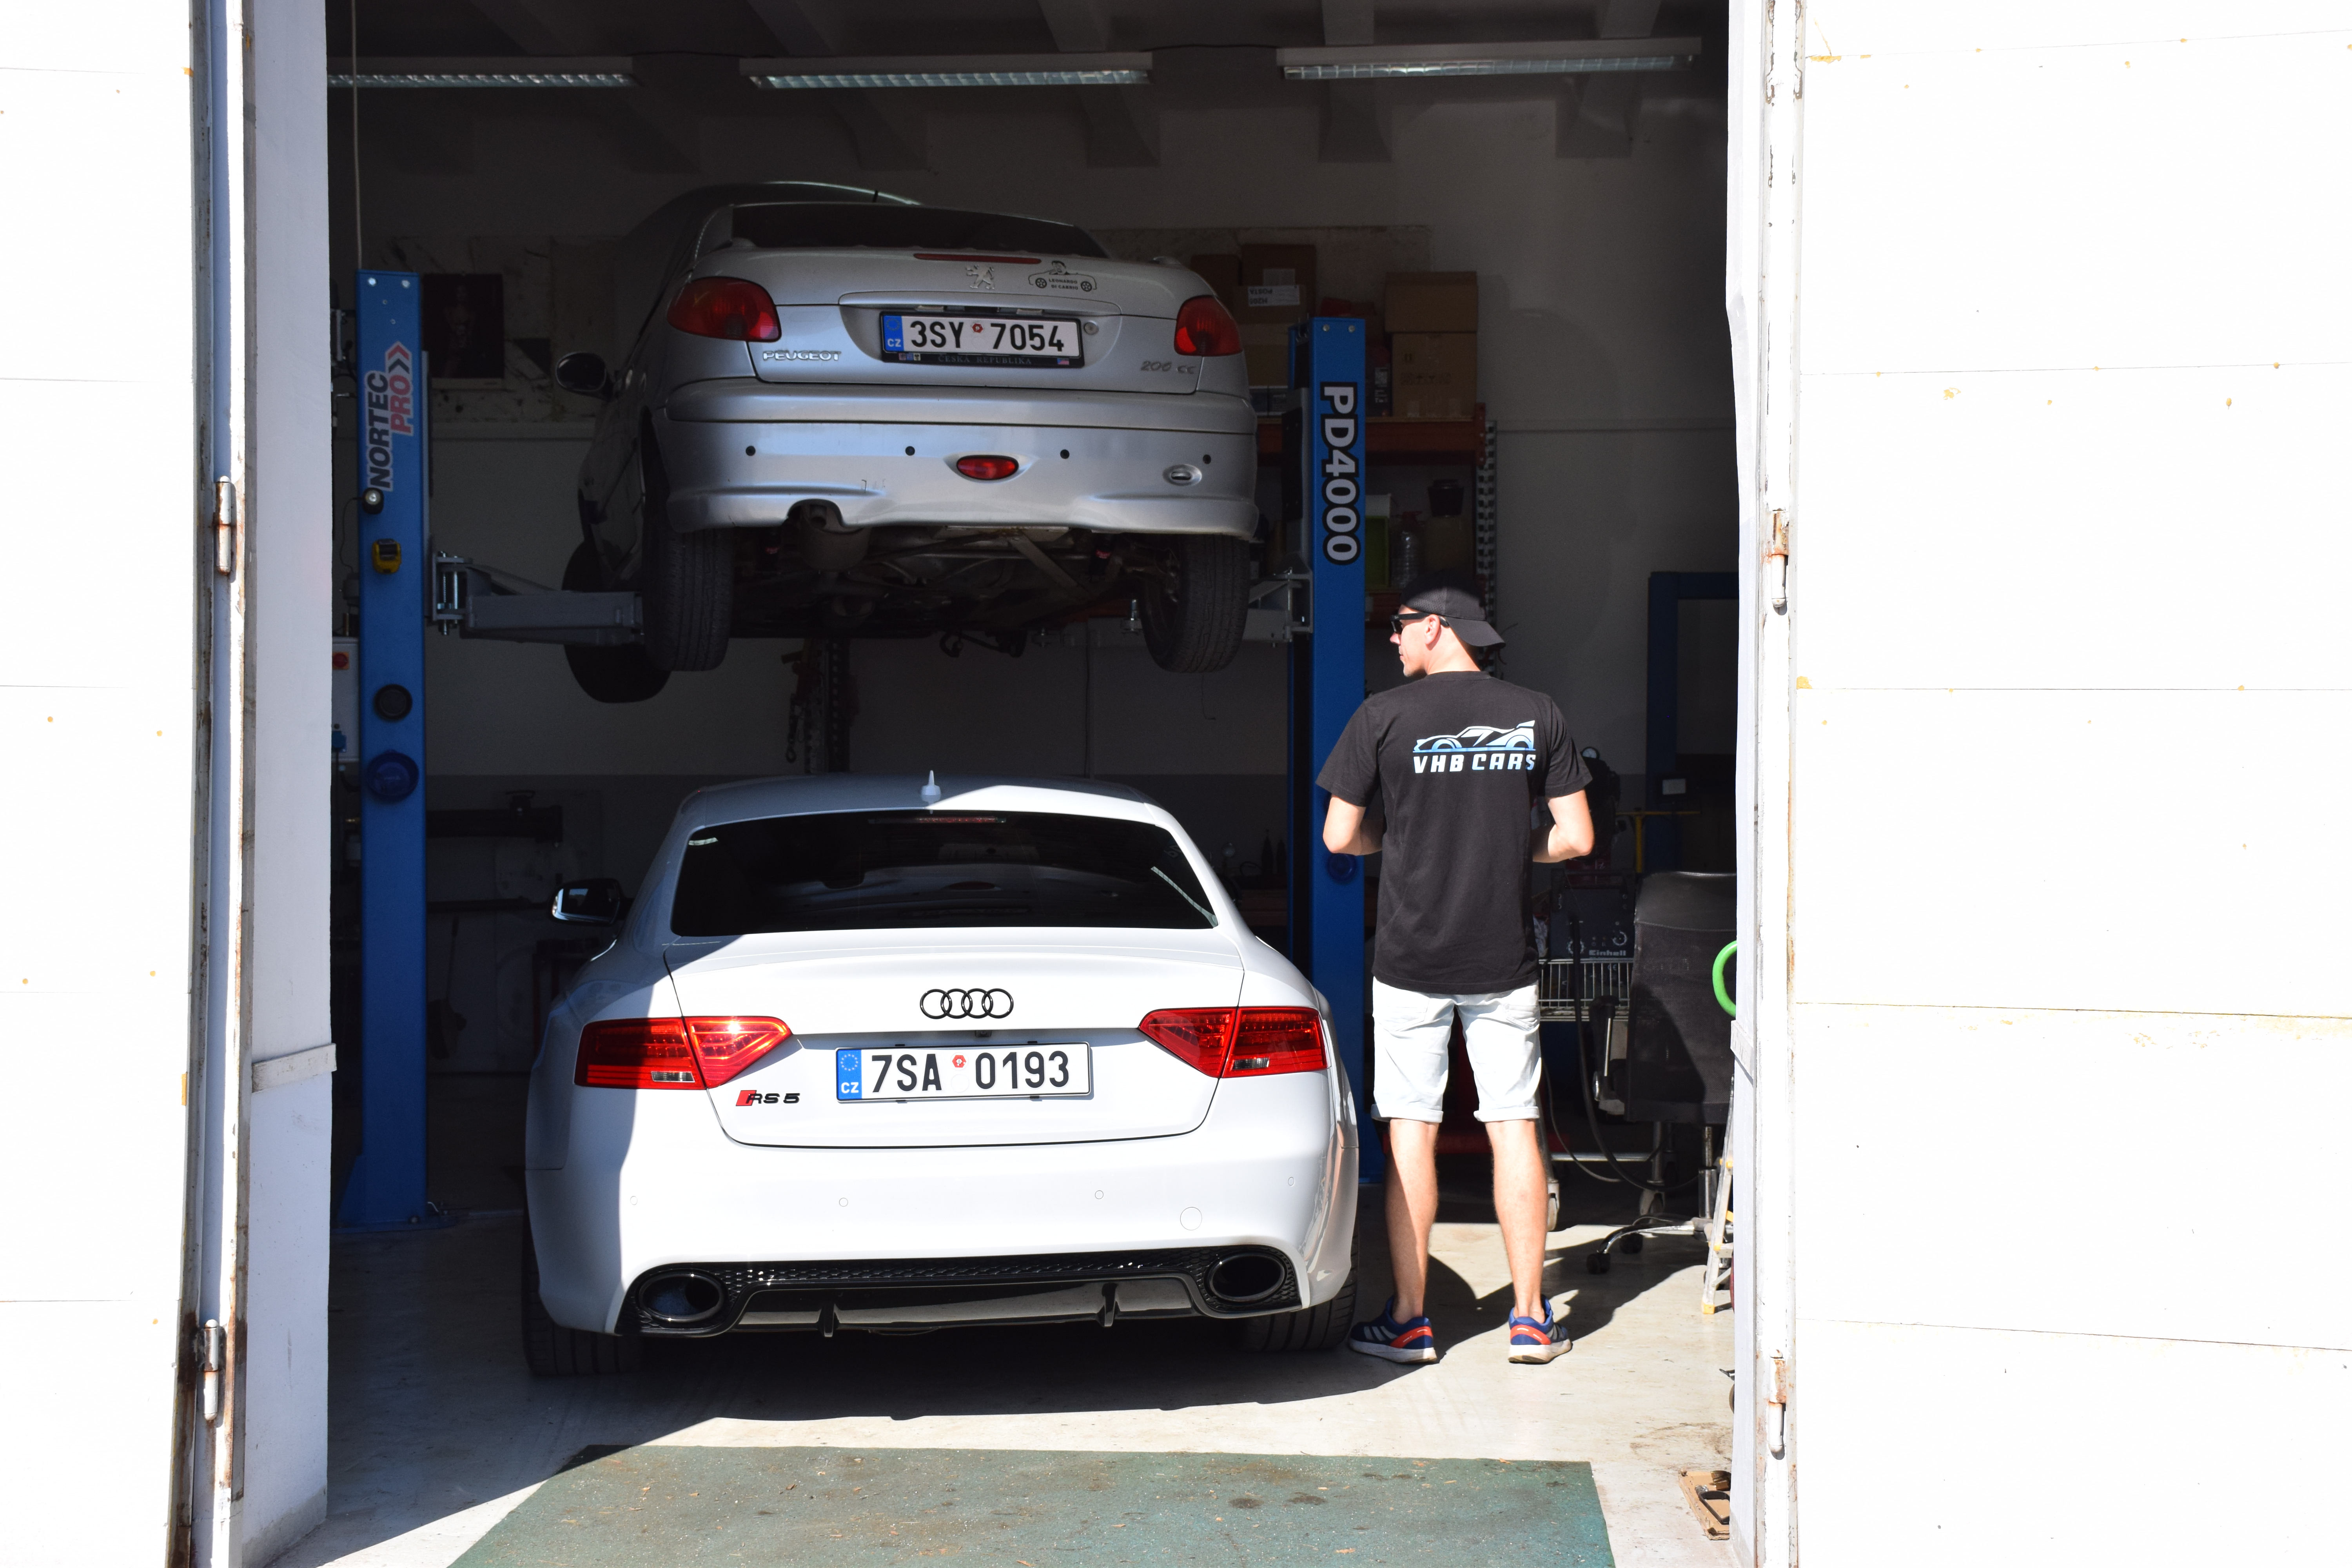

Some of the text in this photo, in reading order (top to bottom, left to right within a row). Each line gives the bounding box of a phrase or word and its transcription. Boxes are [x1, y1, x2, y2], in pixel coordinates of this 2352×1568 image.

[887, 338, 902, 348] CZ
[910, 321, 1064, 352] 3SY 7054
[763, 350, 842, 361] PEUGEOT
[1140, 361, 1173, 372] 206
[389, 374, 411, 434] PRO
[367, 373, 391, 489] NORTEC
[1322, 384, 1359, 563] PD4000
[1413, 753, 1536, 773] VHB CARS
[871, 1051, 1069, 1093] 7SA 0193
[841, 1082, 859, 1094] CZ
[745, 1093, 800, 1104] RS 5
